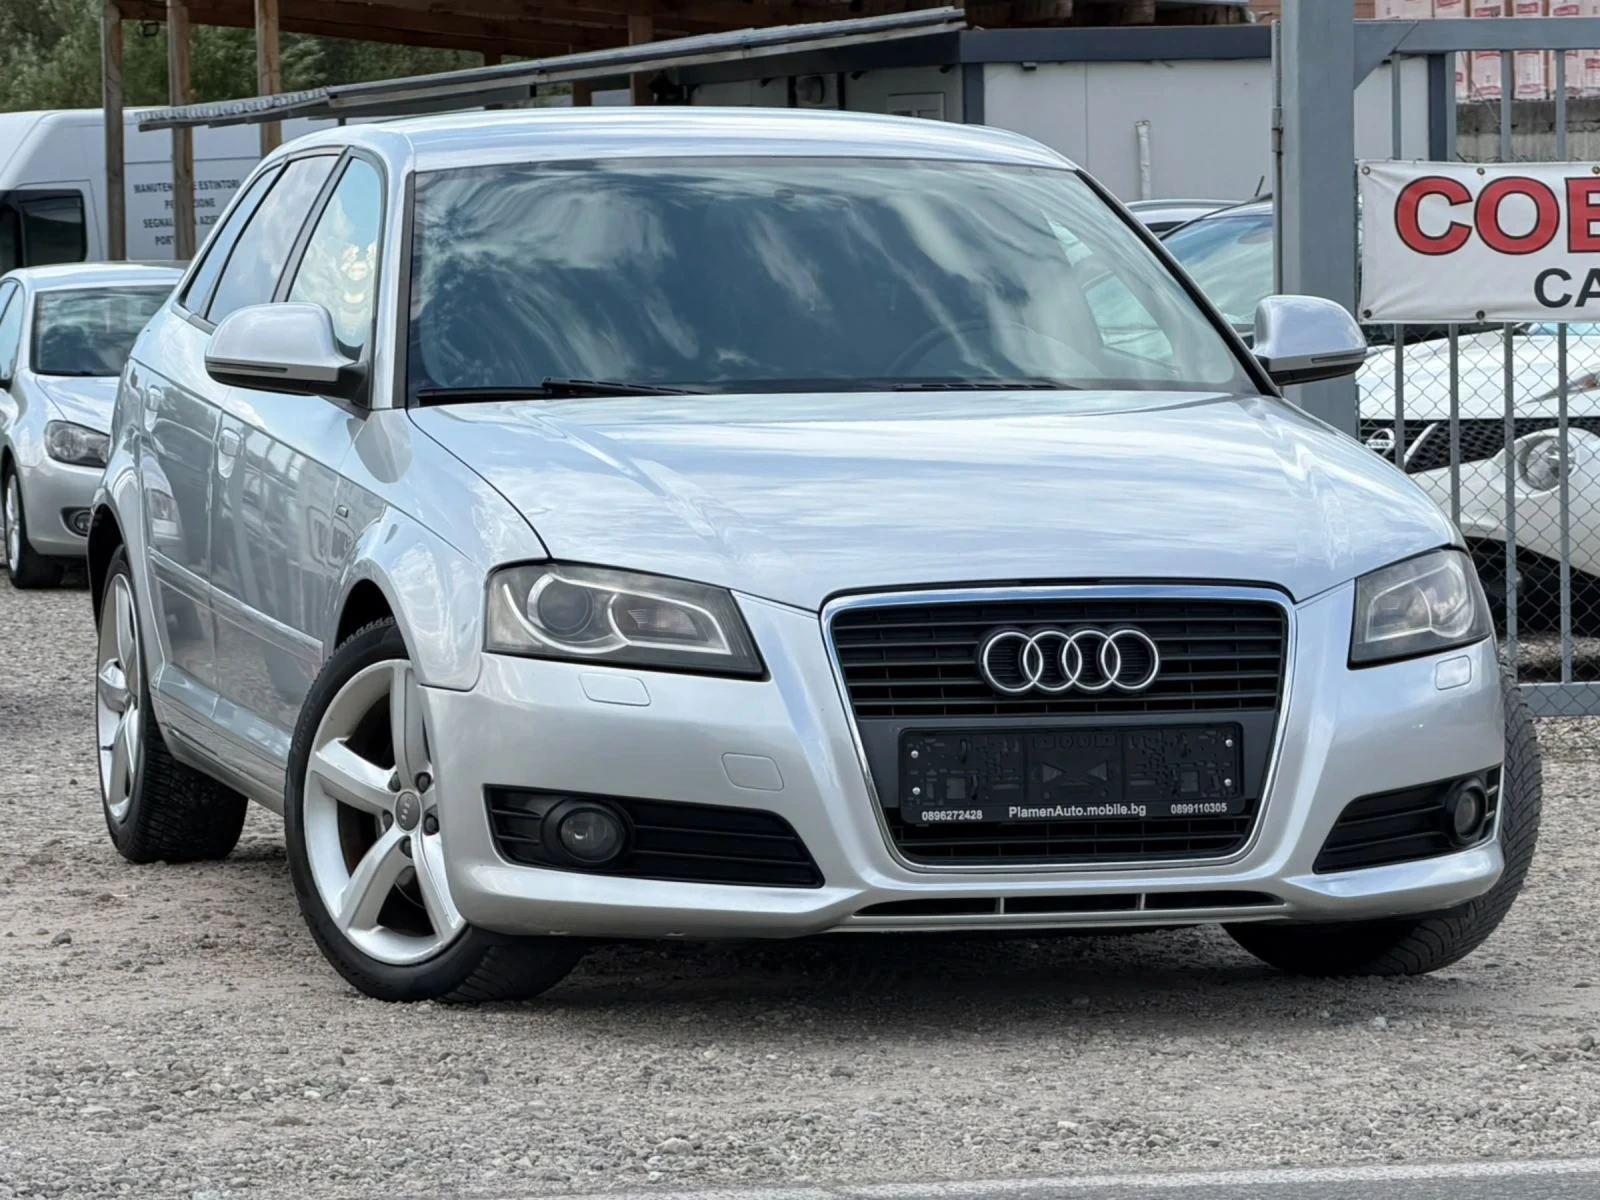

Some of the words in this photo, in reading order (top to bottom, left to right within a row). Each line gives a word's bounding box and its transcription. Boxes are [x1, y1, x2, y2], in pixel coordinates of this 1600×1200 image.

[921, 809, 983, 821] 0896272428
[1008, 802, 1147, 818] PlamenAuto.mobile.bg
[1170, 802, 1228, 815] 0899110305
